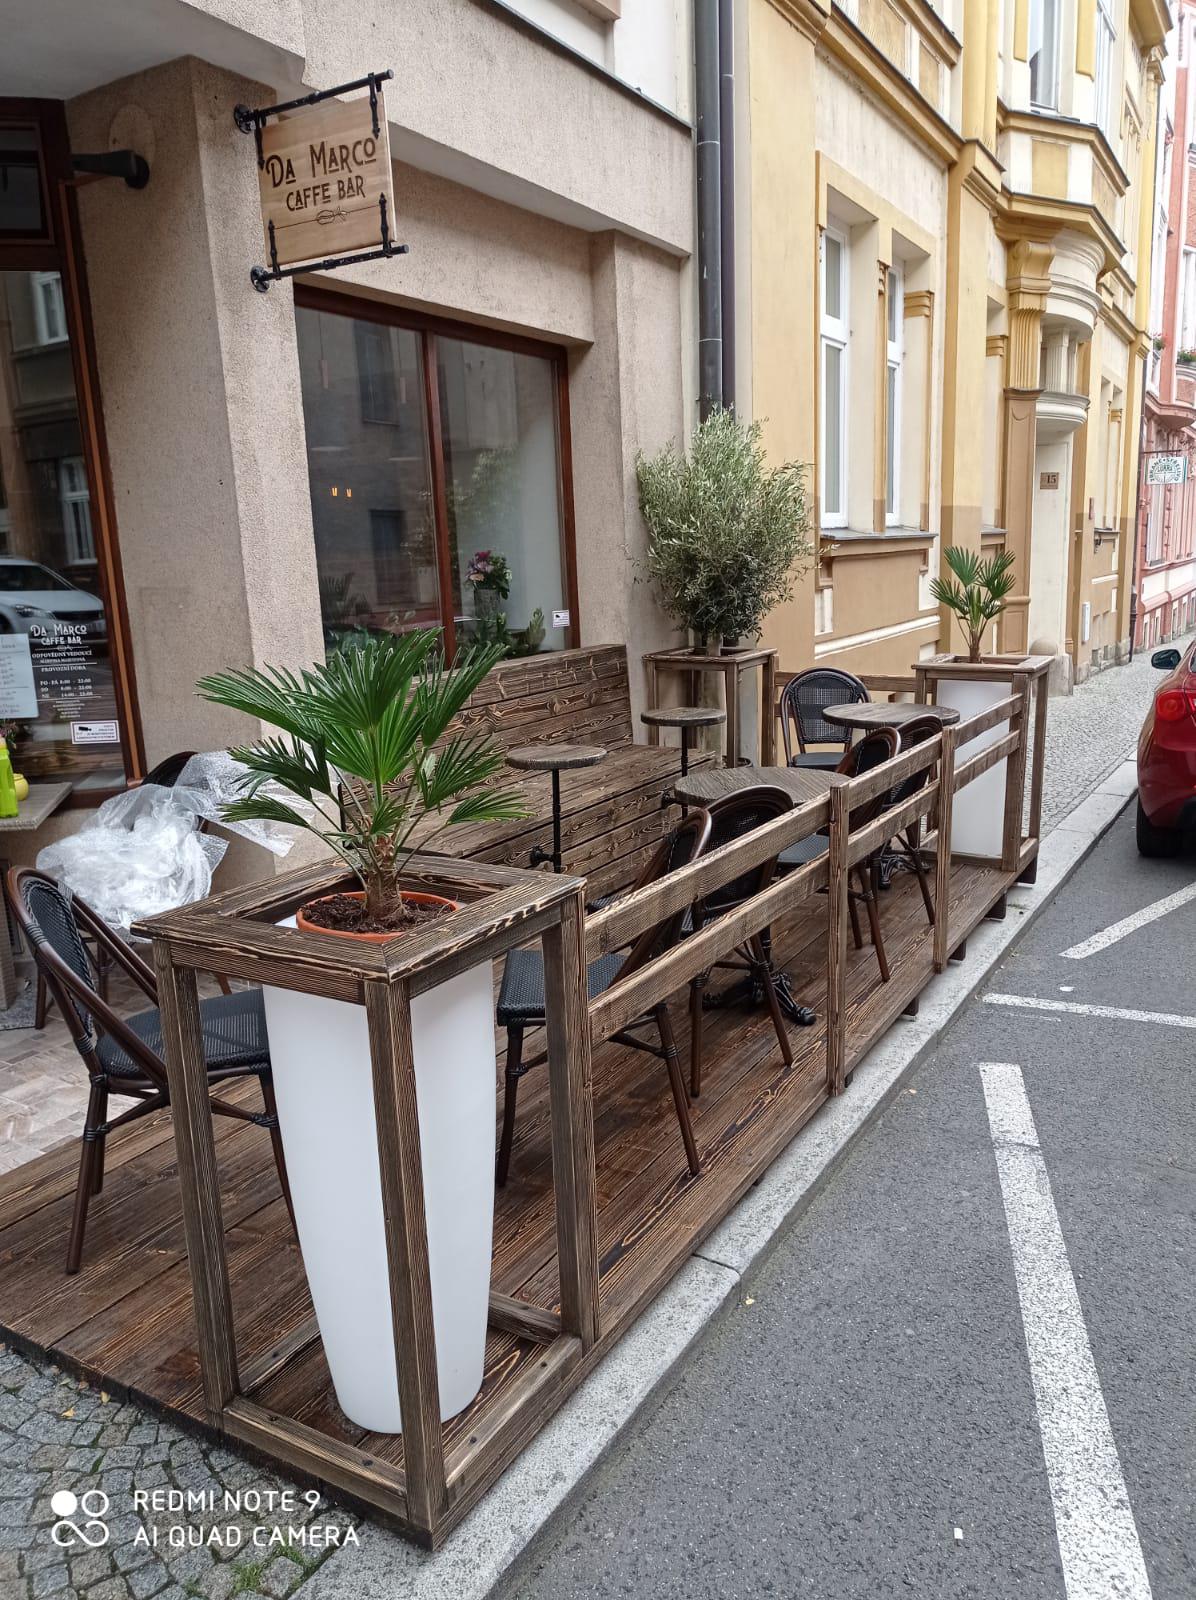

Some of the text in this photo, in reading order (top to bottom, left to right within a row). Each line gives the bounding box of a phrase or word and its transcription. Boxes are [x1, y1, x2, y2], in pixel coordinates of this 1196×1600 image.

[266, 137, 377, 188] DA MARCO
[286, 175, 366, 212] CAFFE BAR
[1047, 474, 1057, 484] 15
[30, 623, 87, 637] DA MARCO
[41, 635, 82, 646] CAFFE BAR
